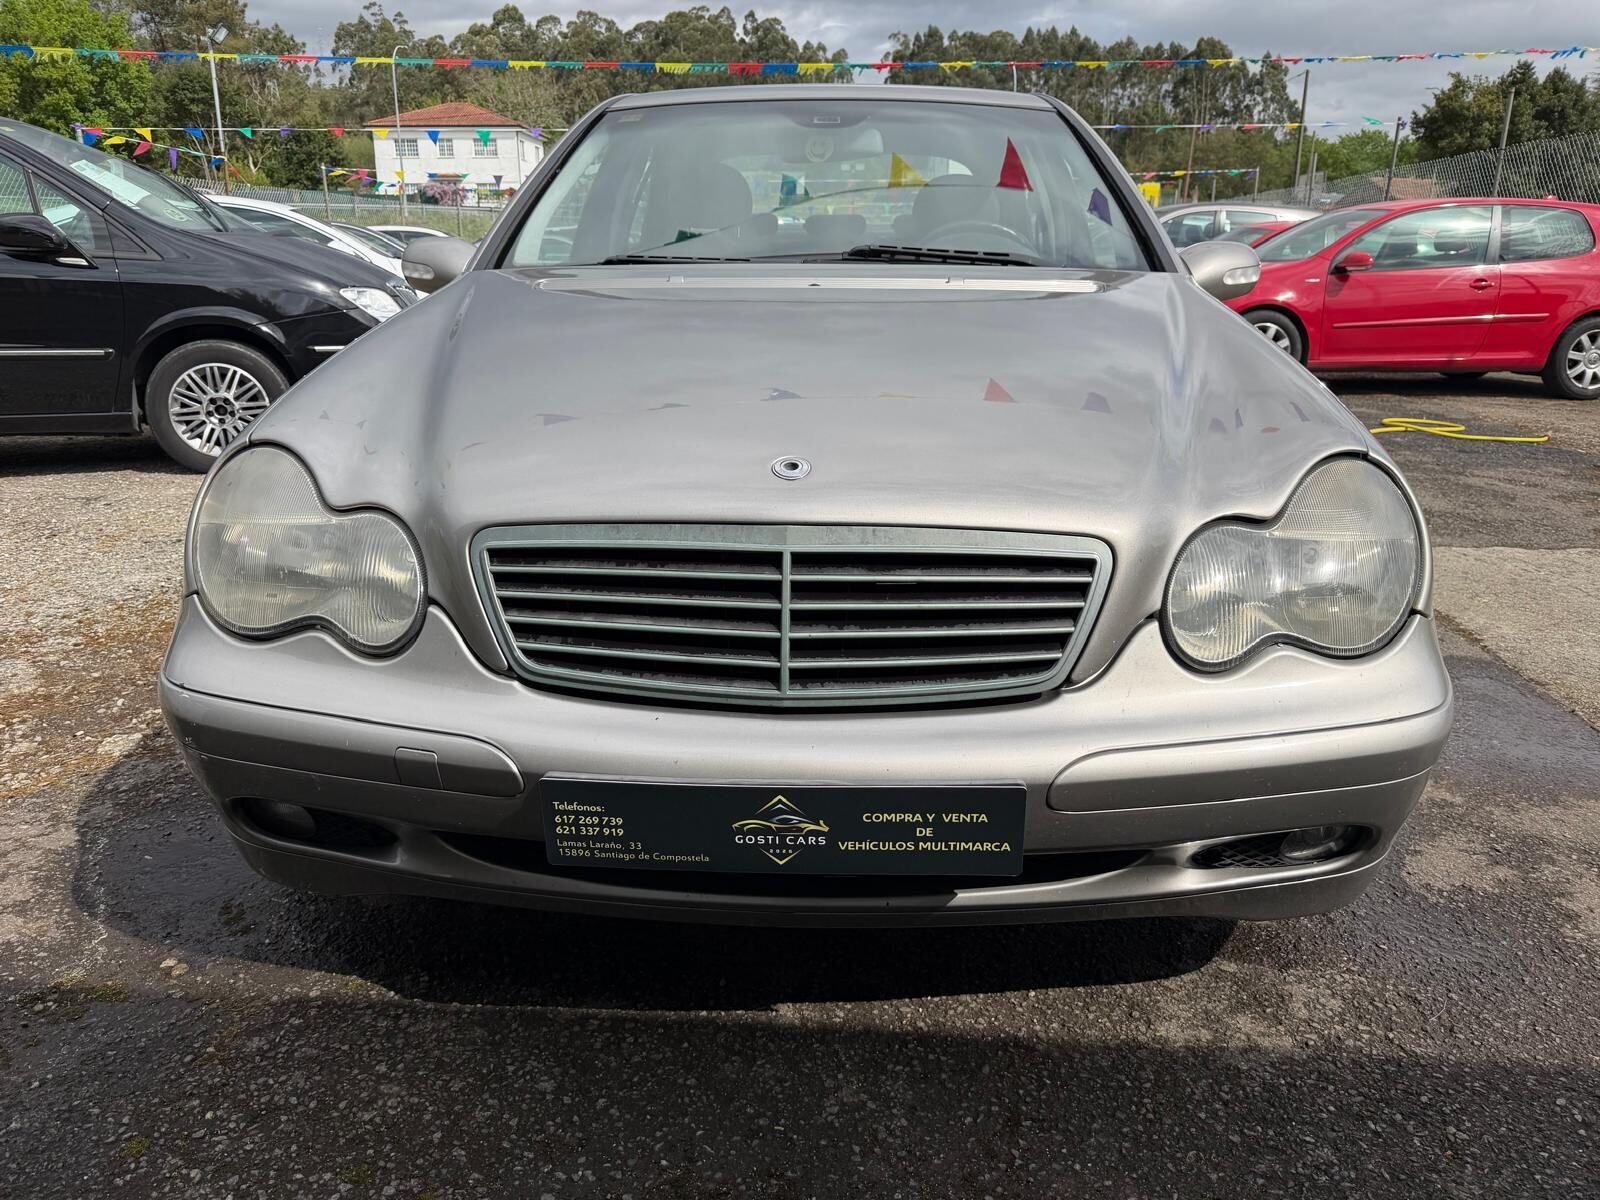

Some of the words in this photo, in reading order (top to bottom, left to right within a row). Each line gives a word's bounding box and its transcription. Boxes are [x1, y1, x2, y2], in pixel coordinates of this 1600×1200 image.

[551, 801, 605, 812] Telefonos:
[554, 814, 576, 824] 617
[578, 815, 600, 825] 269
[601, 816, 624, 826] 739
[862, 813, 923, 823] COMPRA
[926, 813, 936, 823] Y
[941, 813, 989, 823] VENTA
[555, 825, 576, 835] 621
[579, 826, 601, 836] 337
[602, 827, 624, 837] 919
[916, 827, 934, 837] DE
[556, 838, 587, 848] Lamas
[629, 841, 642, 850] 33
[734, 834, 779, 845] GOSTI
[785, 835, 827, 846] CARS
[838, 839, 915, 851] VEHÍCULOS
[918, 841, 1011, 852] MULTIMARCA
[559, 848, 591, 857] 15896
[594, 849, 636, 861] Santiago
[638, 851, 650, 860] de
[652, 852, 710, 863] Compostela
